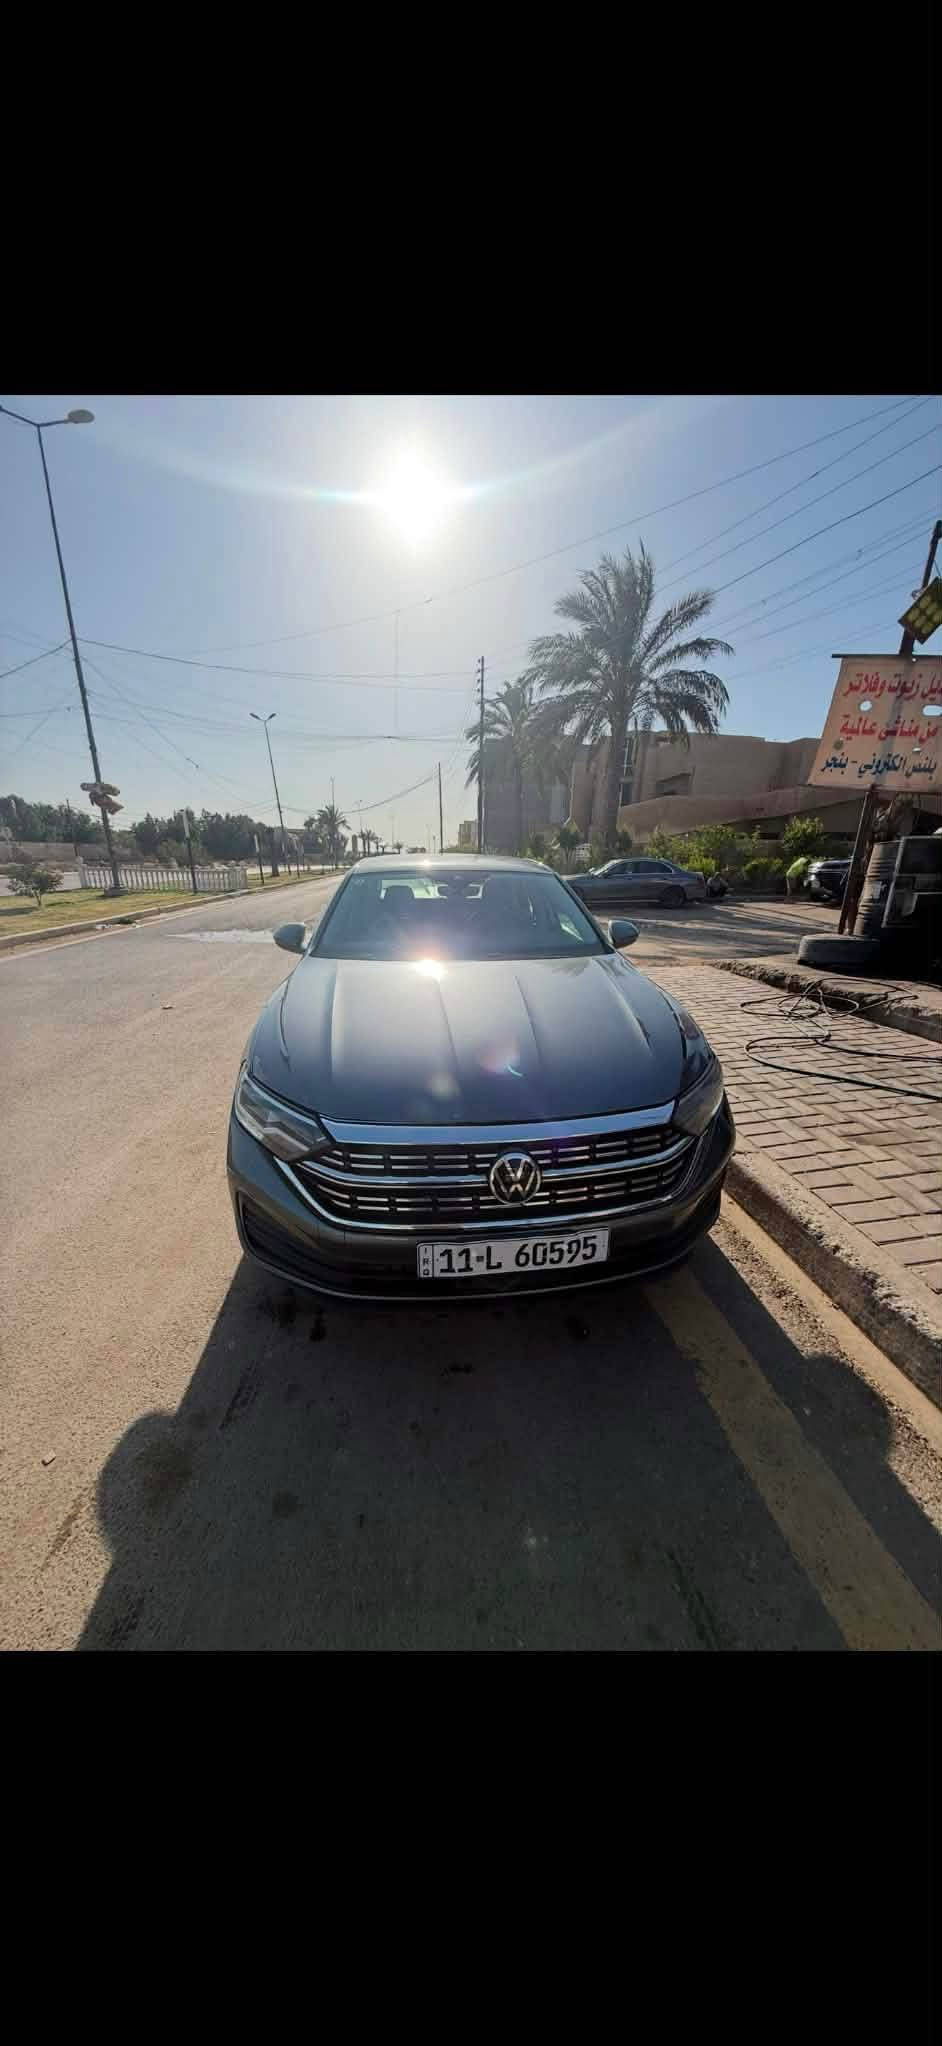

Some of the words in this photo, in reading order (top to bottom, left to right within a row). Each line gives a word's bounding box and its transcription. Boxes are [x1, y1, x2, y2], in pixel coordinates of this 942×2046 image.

[842, 671, 887, 698] وفلاتر
[888, 673, 922, 701] زيوت
[918, 721, 938, 744] من
[514, 1235, 598, 1268] 60595
